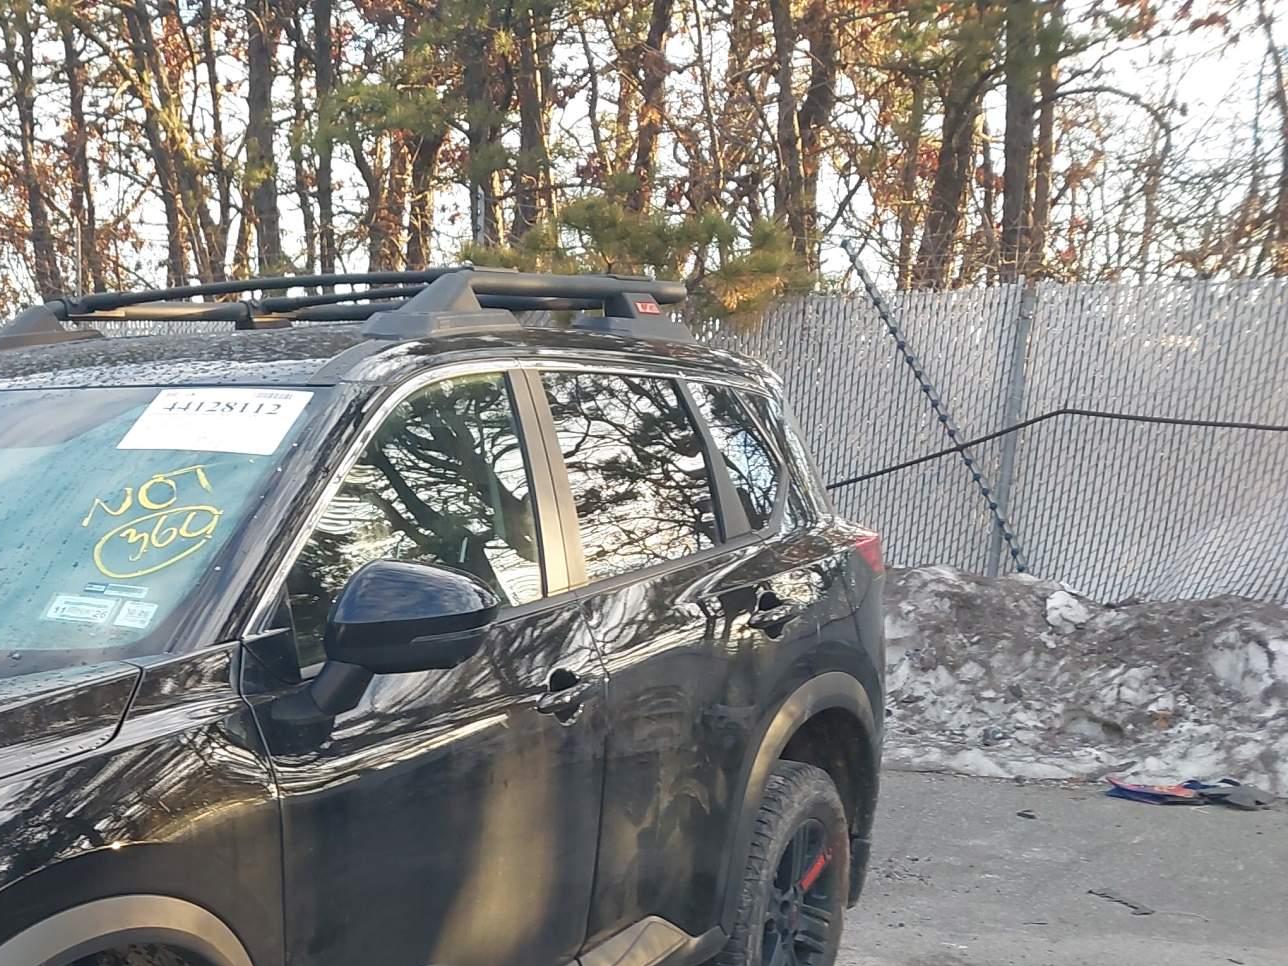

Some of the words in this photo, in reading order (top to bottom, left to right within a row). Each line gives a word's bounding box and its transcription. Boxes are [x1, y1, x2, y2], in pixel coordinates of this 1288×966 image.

[162, 401, 282, 415] 44128112
[81, 464, 213, 527] NOT
[120, 510, 220, 562] 360
